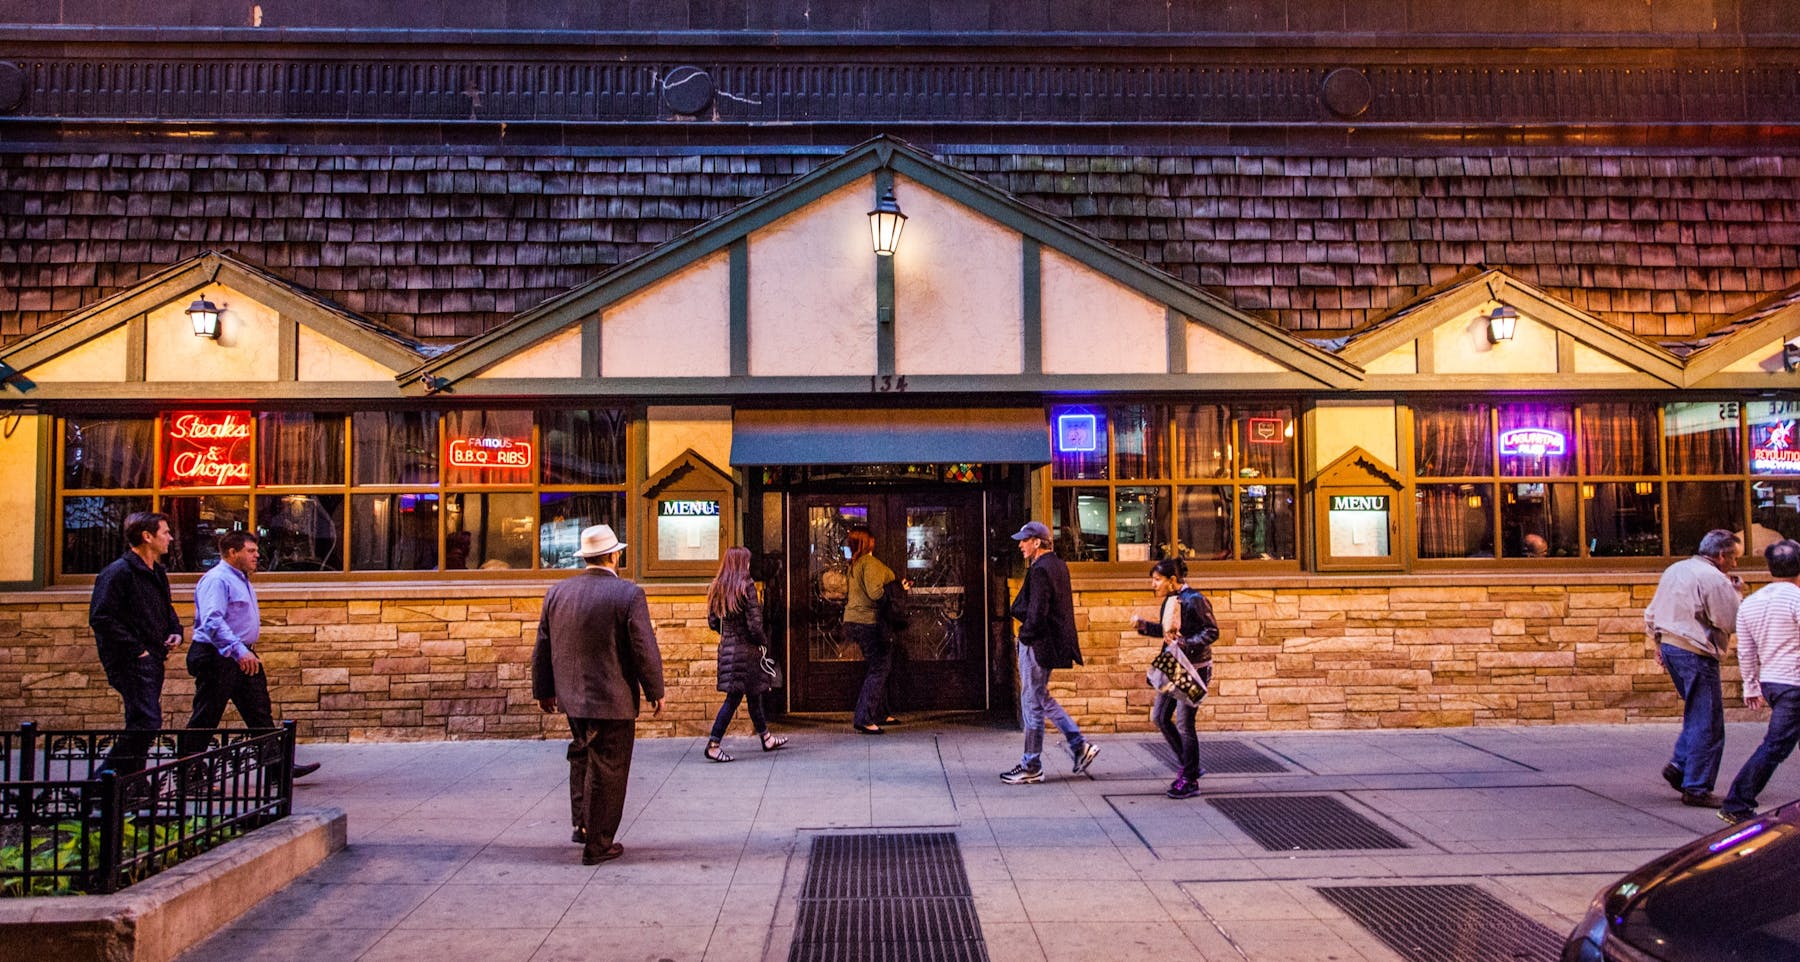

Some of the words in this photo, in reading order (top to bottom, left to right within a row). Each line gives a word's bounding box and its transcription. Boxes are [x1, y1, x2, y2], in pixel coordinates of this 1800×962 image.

[870, 375, 908, 392] 134
[171, 415, 250, 438] Steaks
[468, 438, 513, 448] FAMOUS
[206, 446, 218, 461] &
[497, 451, 526, 464] RIBS
[174, 452, 249, 485] Chops
[663, 501, 715, 515] MENU
[1334, 496, 1384, 510] MENU
